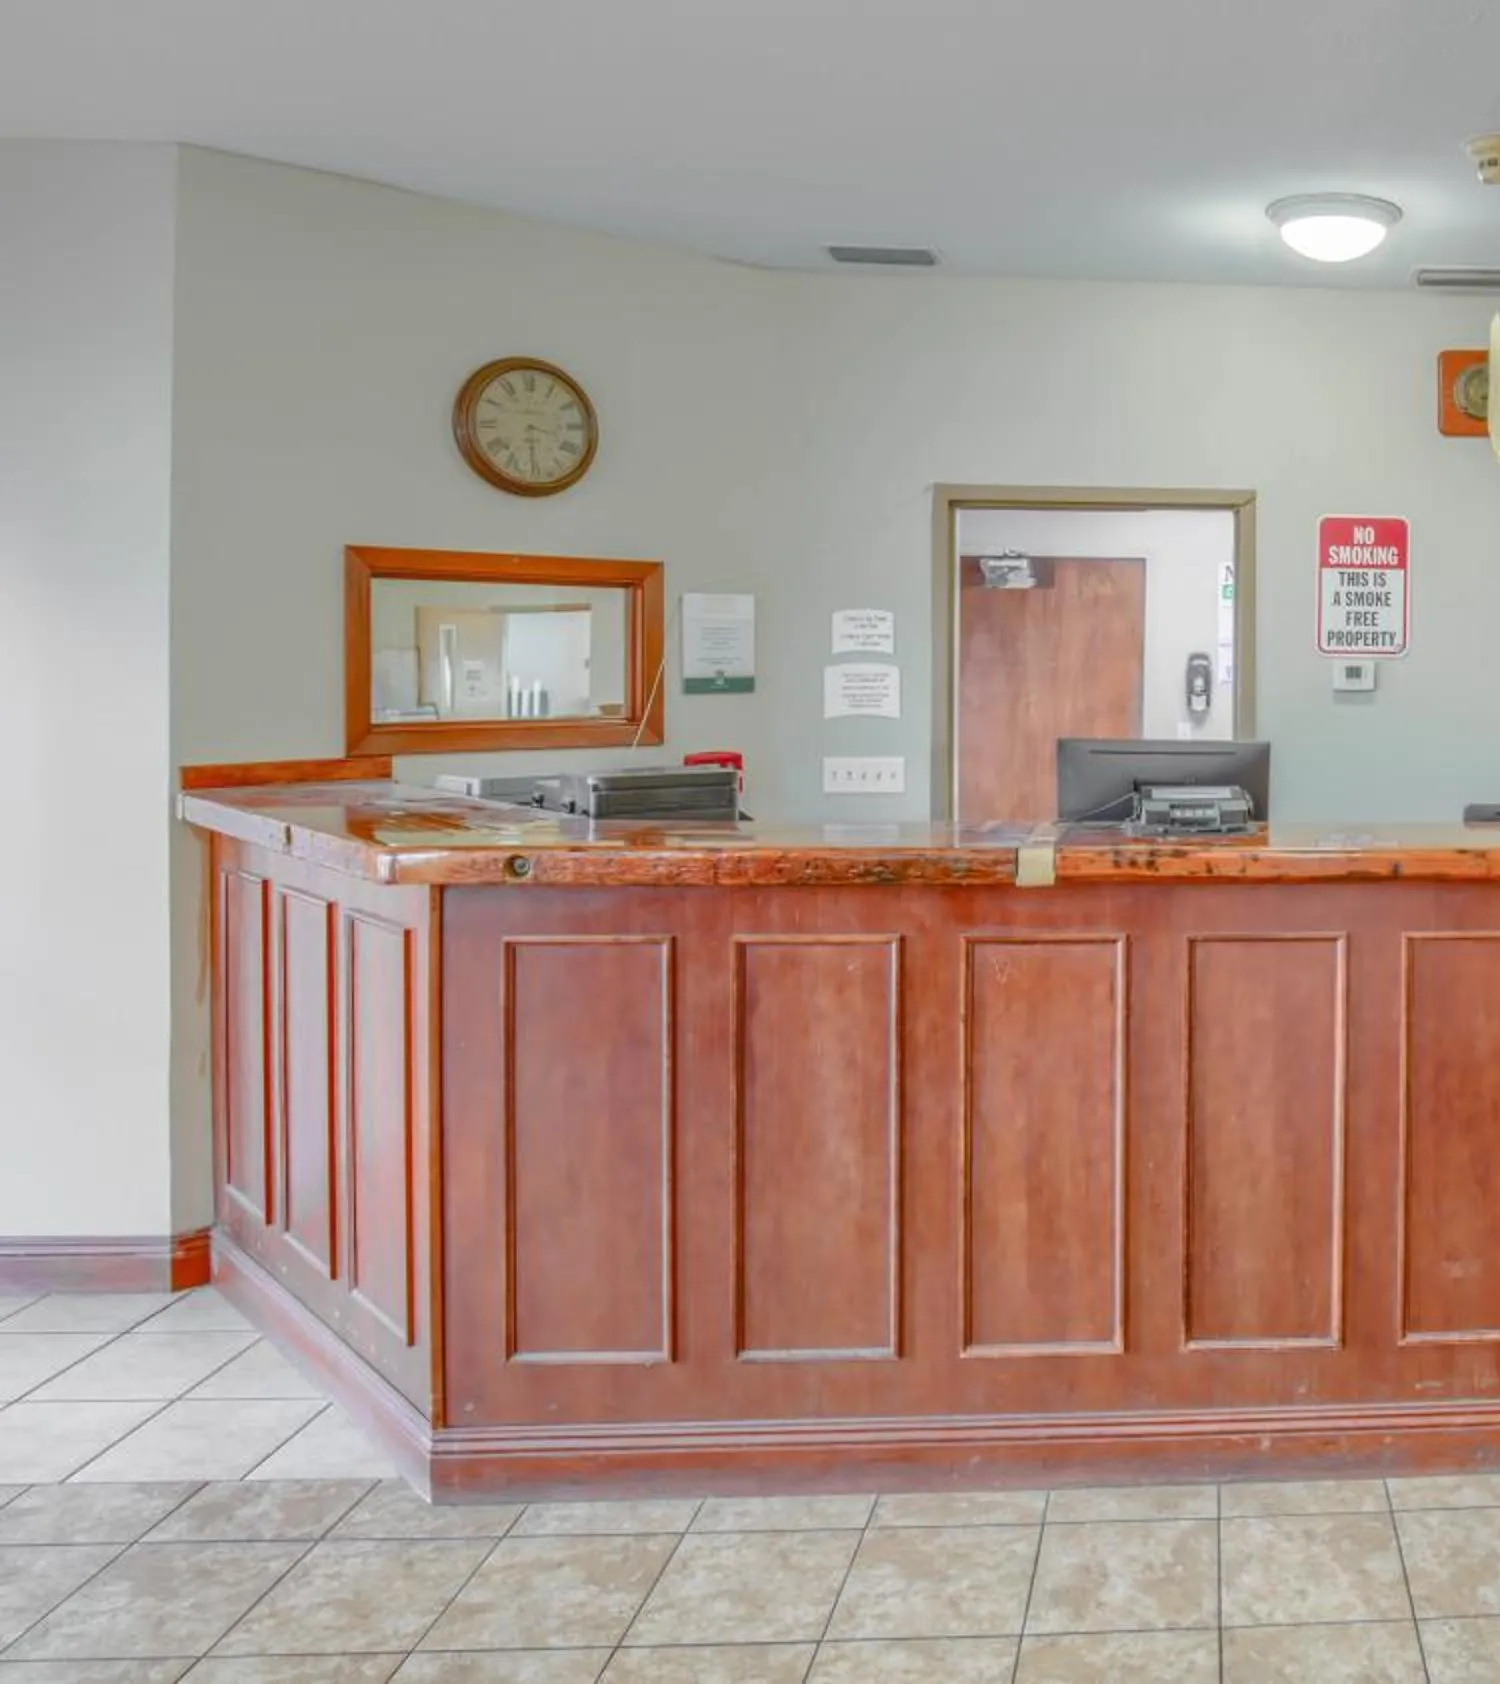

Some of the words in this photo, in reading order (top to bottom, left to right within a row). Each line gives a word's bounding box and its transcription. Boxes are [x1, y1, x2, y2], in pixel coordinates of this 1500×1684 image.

[1353, 526, 1375, 544] NO
[1328, 546, 1399, 565] SMOKING
[1338, 571, 1369, 587] THIS
[1373, 572, 1387, 587] IS
[1331, 591, 1341, 606] A
[1345, 592, 1392, 607] SMOKE
[1345, 611, 1379, 627] FREE
